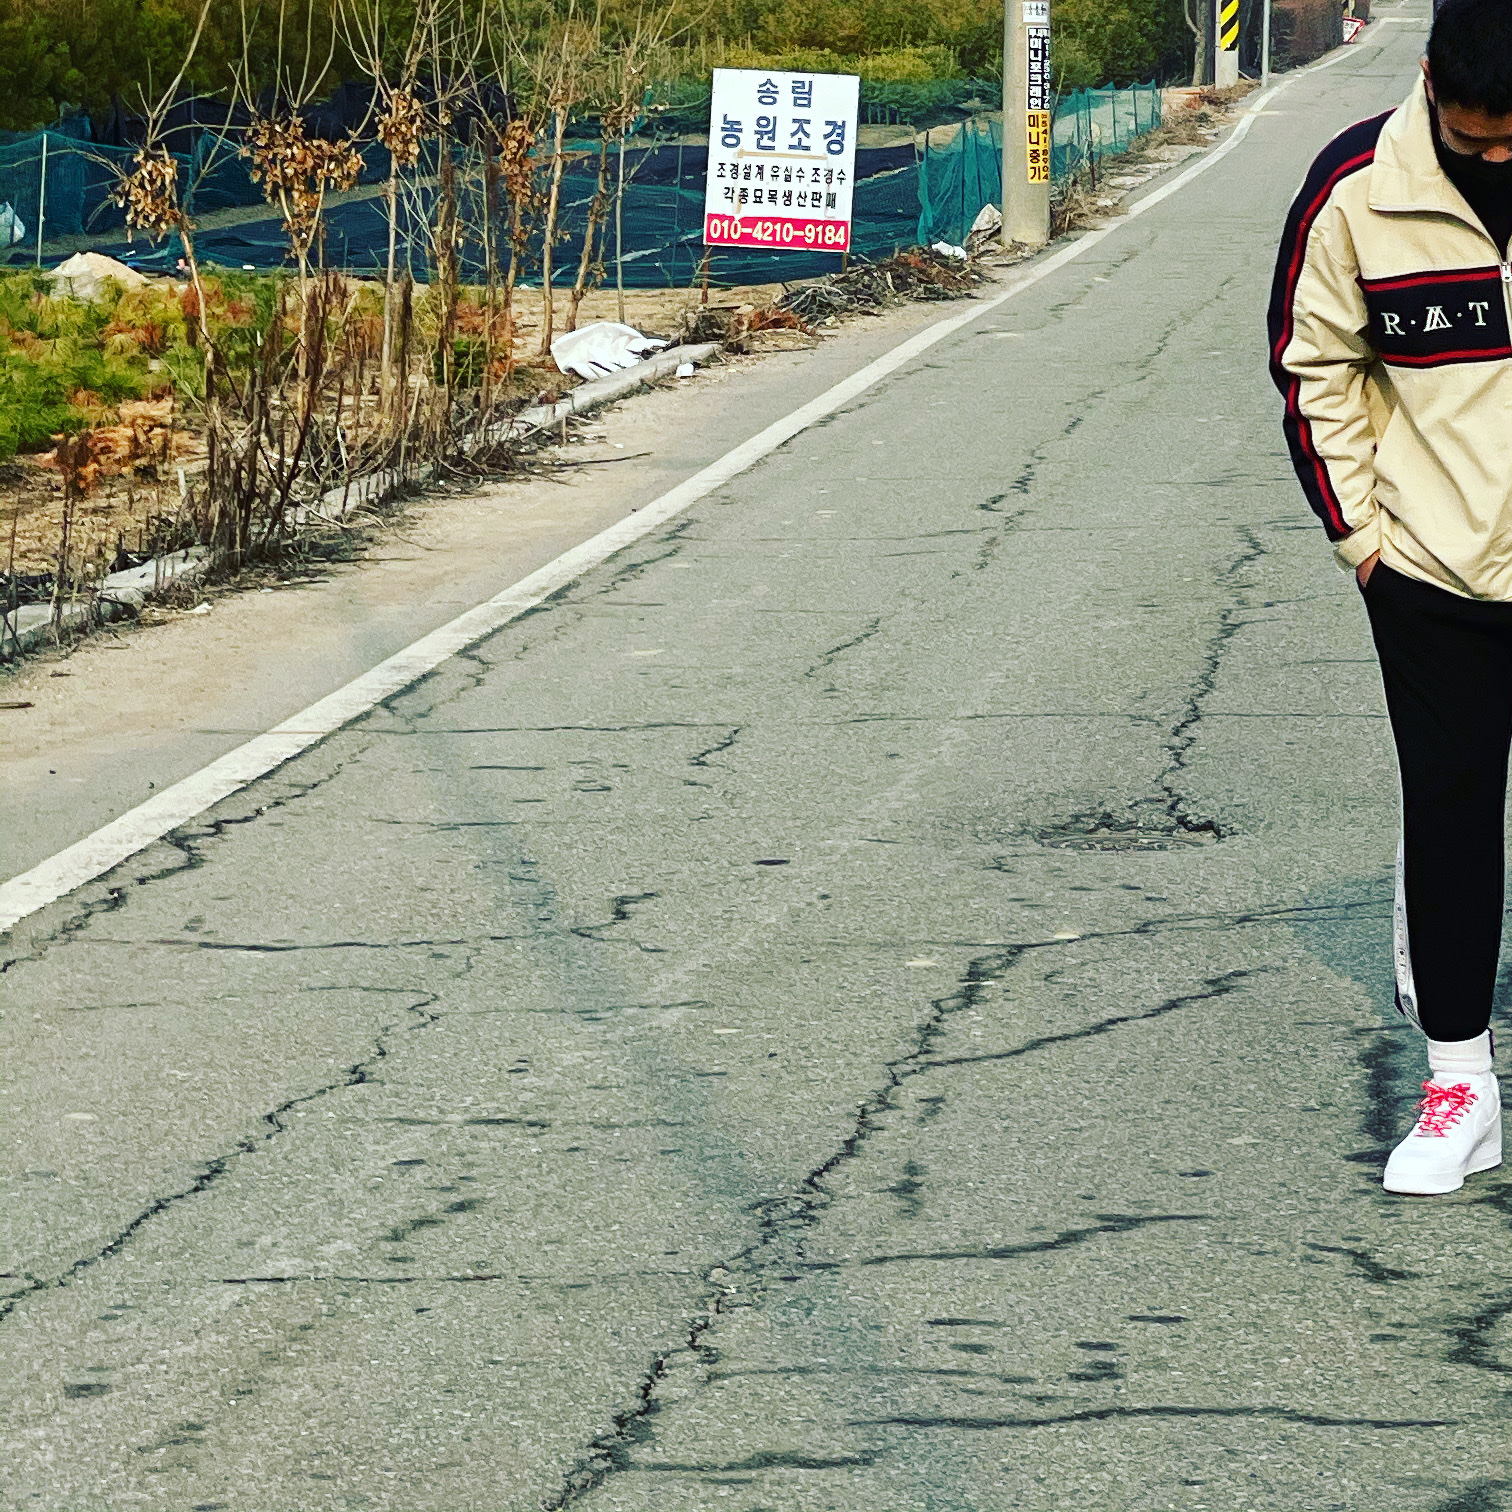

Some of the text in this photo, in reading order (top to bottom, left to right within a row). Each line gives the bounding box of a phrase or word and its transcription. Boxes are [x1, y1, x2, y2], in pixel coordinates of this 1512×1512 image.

[757, 78, 813, 108] 송림
[720, 113, 846, 155] 농원조경
[709, 218, 846, 246] 010-4210-9184
